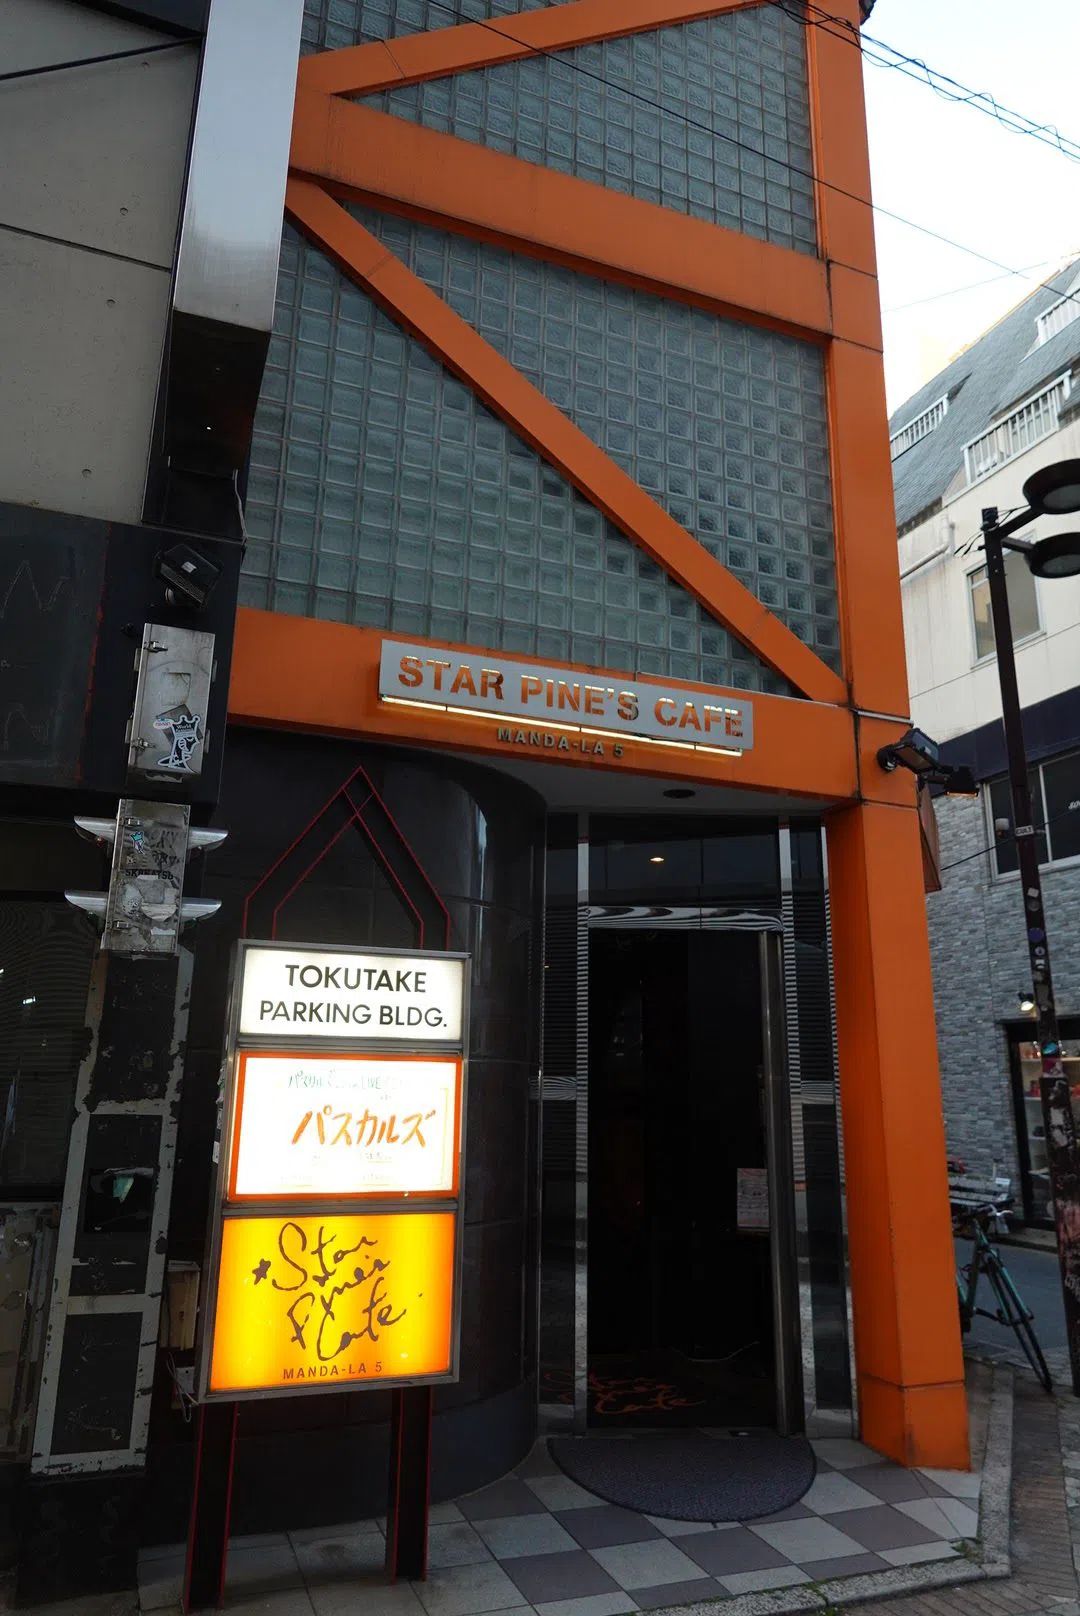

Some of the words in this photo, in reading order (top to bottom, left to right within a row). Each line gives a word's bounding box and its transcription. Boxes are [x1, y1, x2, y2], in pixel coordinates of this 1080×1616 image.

[398, 655, 505, 701] STAR
[520, 674, 639, 722] PINE'S
[653, 697, 744, 739] CAFE
[497, 727, 605, 757] MANDA-LA
[613, 742, 625, 758] 5
[285, 964, 427, 993] TOKUTAKE
[259, 1000, 372, 1025] PARKING
[379, 1005, 448, 1028] BLDG.
[291, 1104, 437, 1148] パスカルズ
[271, 1222, 378, 1291] Star
[283, 1361, 367, 1380] MANDA-LA
[375, 1362, 383, 1373] 5
